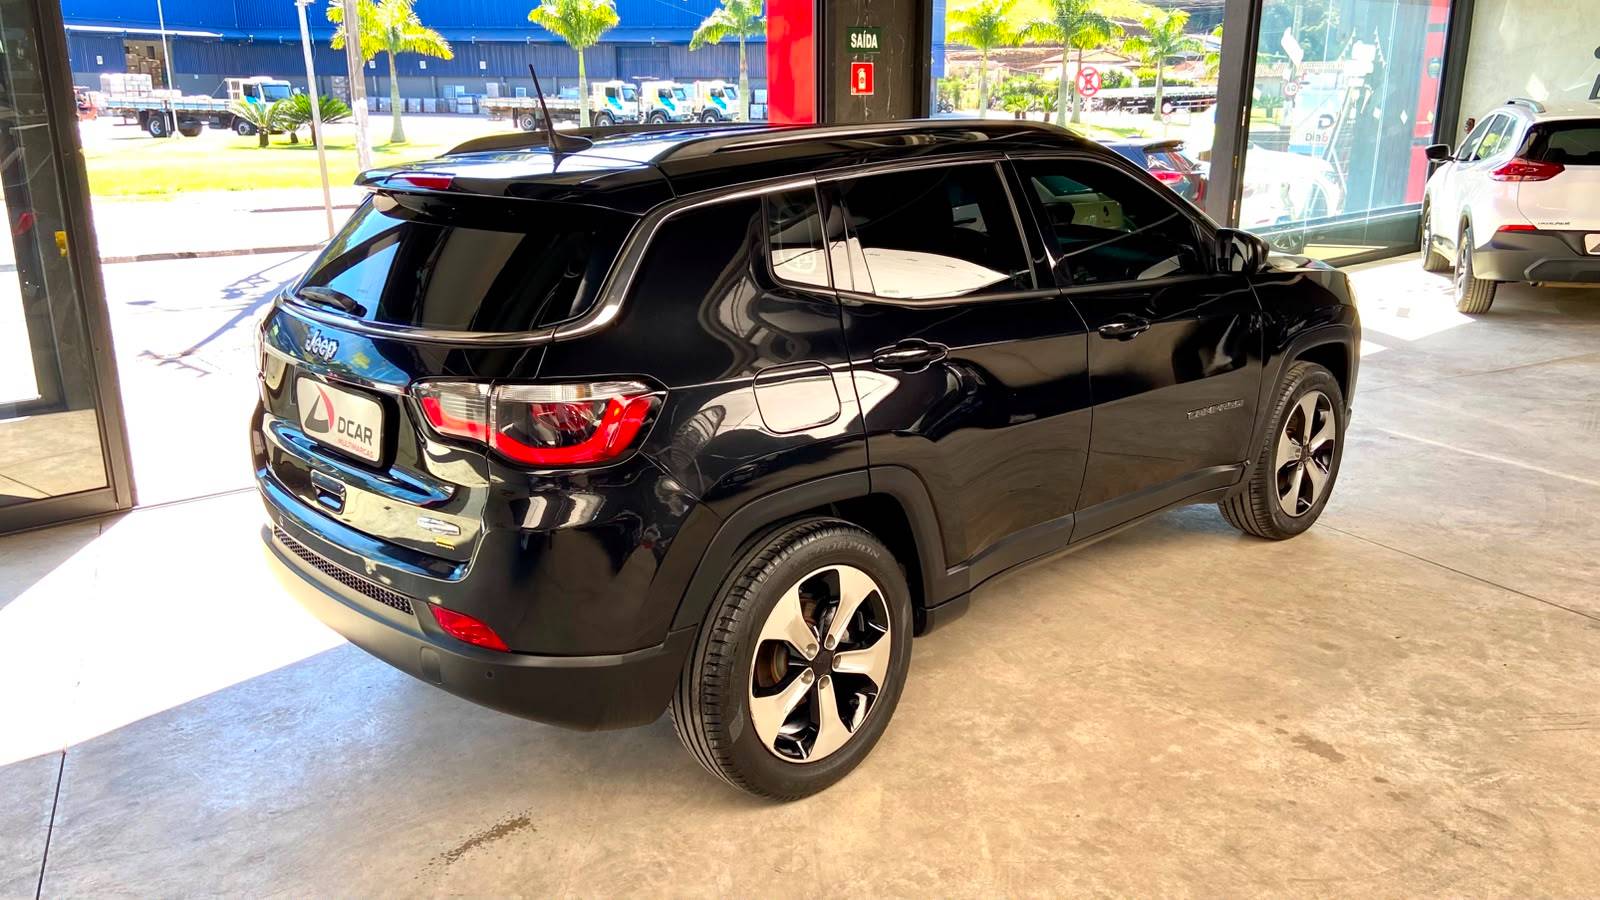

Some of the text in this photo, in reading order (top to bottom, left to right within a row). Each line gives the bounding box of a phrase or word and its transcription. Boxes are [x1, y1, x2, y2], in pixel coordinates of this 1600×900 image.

[850, 29, 878, 48] SAÍDA
[305, 330, 338, 360] Jeep
[337, 416, 373, 446] DCAR
